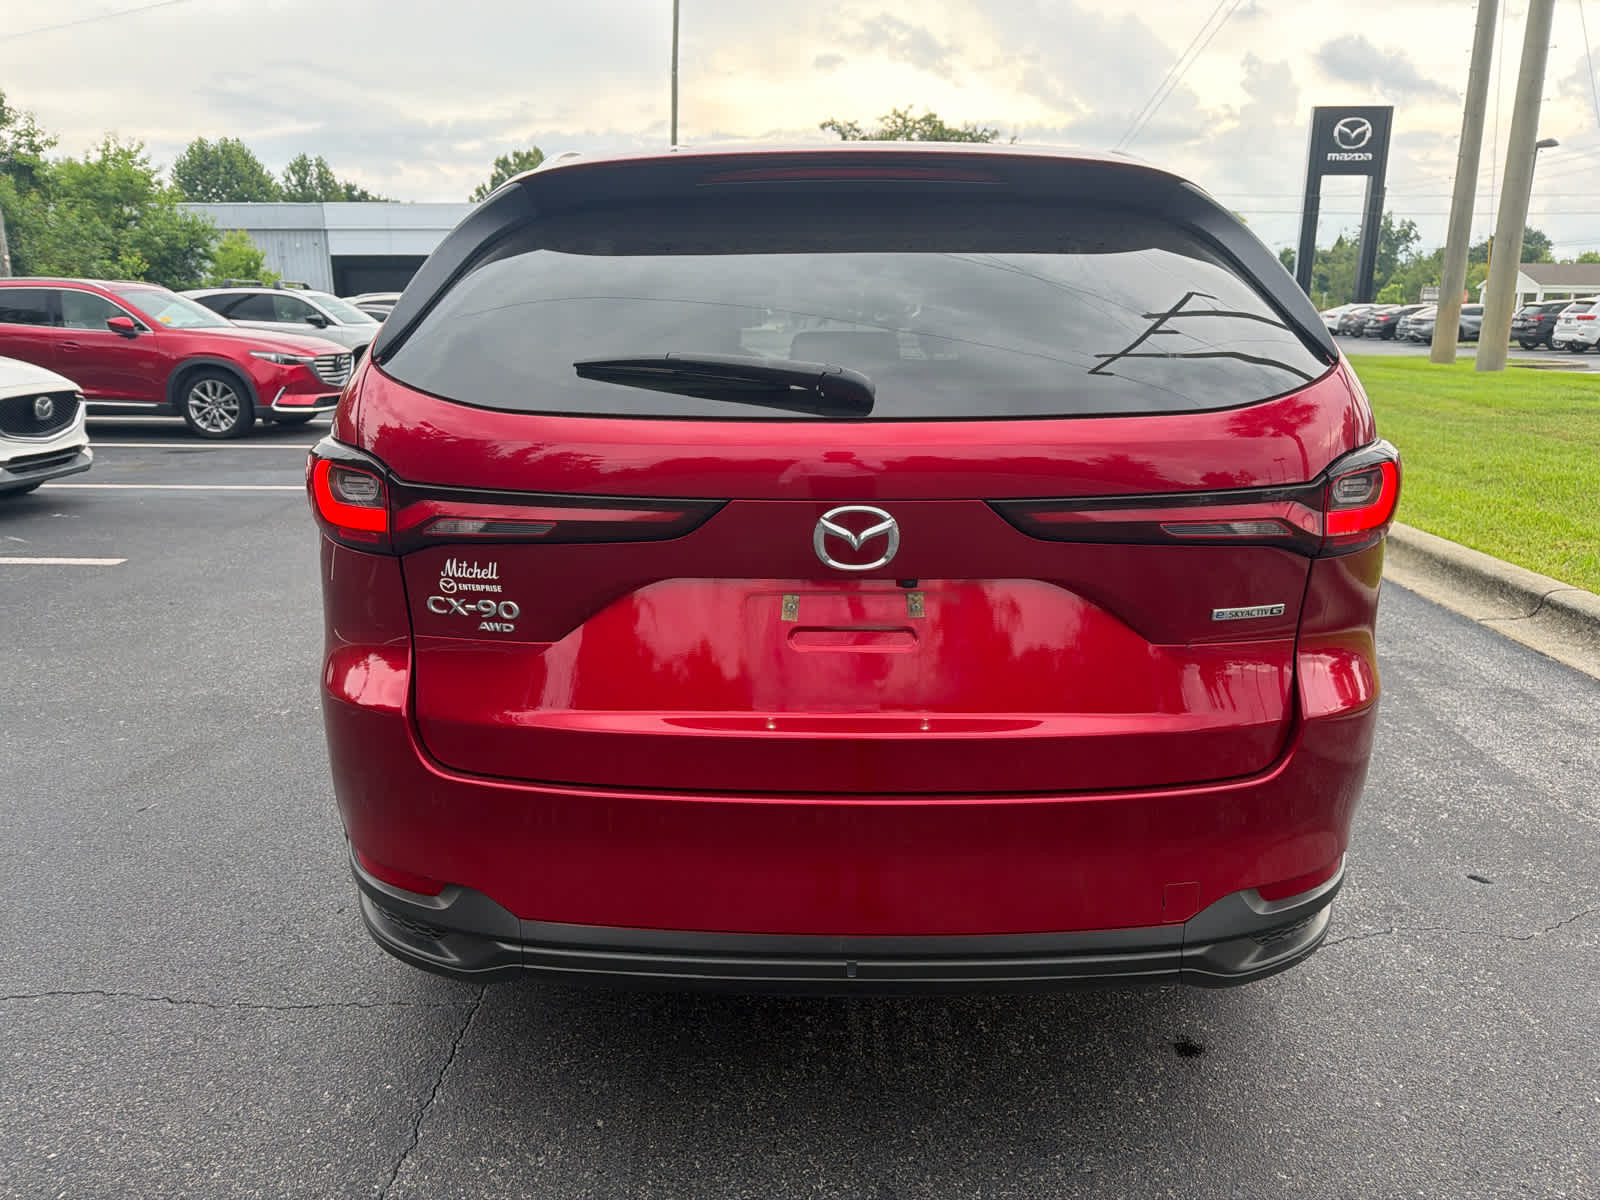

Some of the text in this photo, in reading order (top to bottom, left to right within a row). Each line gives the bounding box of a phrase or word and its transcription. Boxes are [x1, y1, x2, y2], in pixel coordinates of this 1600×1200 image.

[440, 558, 499, 579] Mitchell
[458, 583, 502, 592] ENTERPRISE
[427, 596, 520, 619] CX-90
[479, 621, 515, 632] AWD
